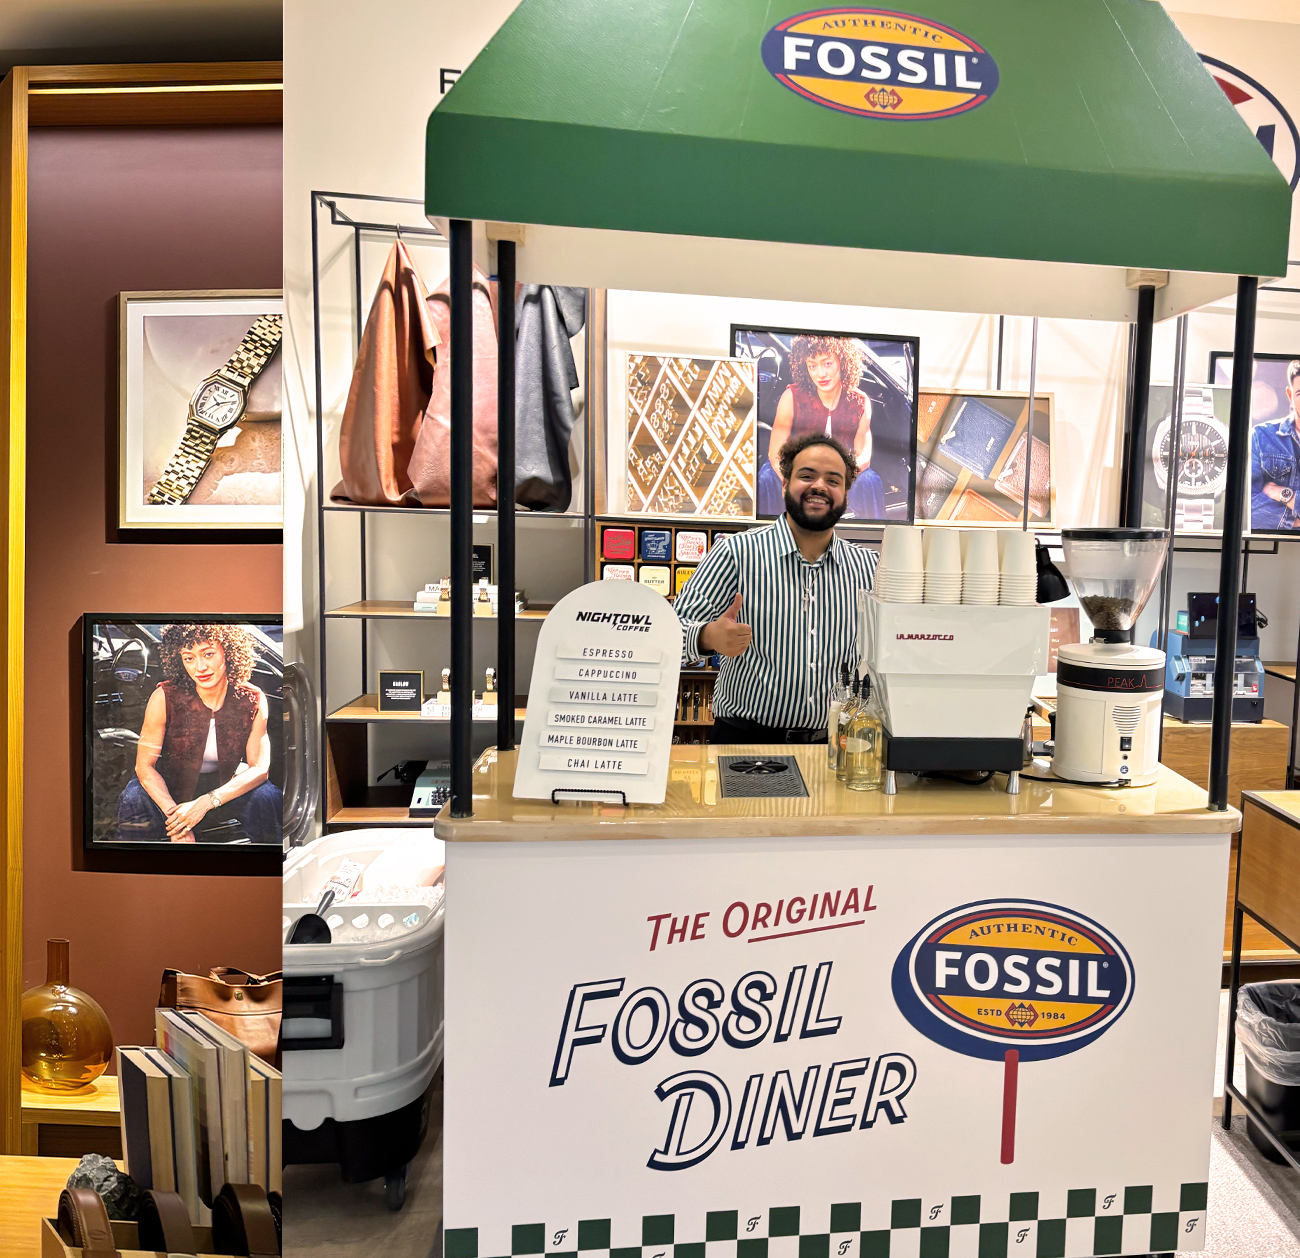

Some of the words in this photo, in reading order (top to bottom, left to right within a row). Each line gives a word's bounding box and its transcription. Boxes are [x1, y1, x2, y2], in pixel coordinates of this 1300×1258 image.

[822, 18, 943, 44] AUTHENTIC
[575, 611, 652, 627] NIGHTOWL
[616, 624, 651, 633] COFFEE
[582, 648, 634, 659] ESPRESSO
[578, 668, 637, 680] CAPPUCCINO
[1107, 677, 1135, 688] PEAK
[569, 691, 607, 701] VANILLA
[611, 692, 638, 703] LATTE
[554, 714, 585, 724] SMOKED
[587, 715, 623, 726] CARAMEL
[625, 717, 647, 726] LATTE
[547, 734, 574, 745] MAPLE
[576, 736, 614, 748] BOURBON
[615, 738, 638, 749] LATTE
[567, 758, 589, 769] CHAI
[594, 760, 623, 770] LATTE
[968, 923, 1078, 946] AUTHENTIC
[977, 1008, 1002, 1017] ESTD
[1041, 1011, 1066, 1020] 1984
